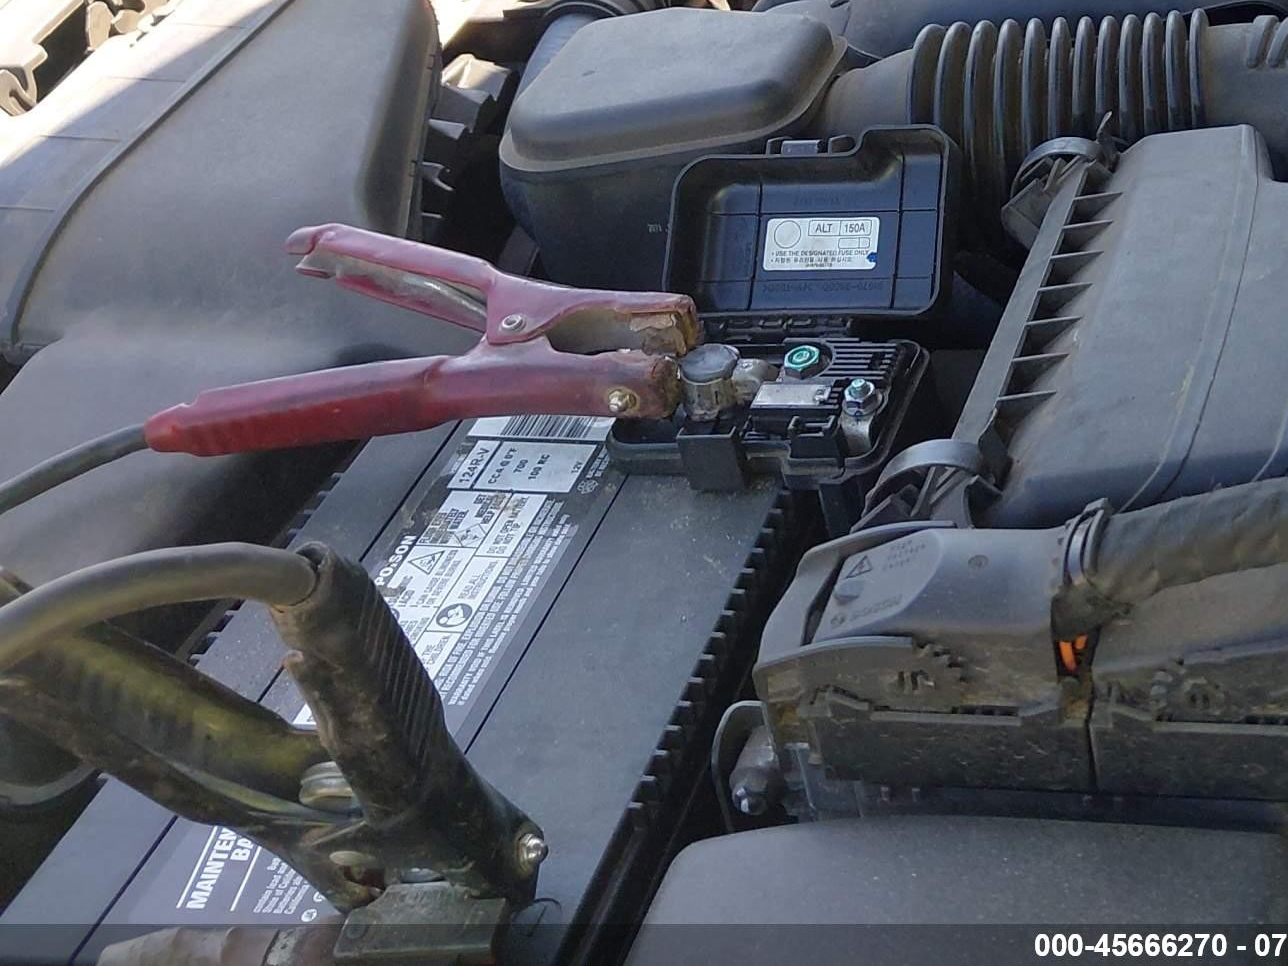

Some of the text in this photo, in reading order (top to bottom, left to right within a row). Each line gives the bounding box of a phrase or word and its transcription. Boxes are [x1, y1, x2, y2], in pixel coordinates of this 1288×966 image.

[815, 223, 833, 233] ALT
[844, 222, 865, 233] 150A
[459, 447, 490, 484] 124R-V
[513, 459, 529, 474] 700
[528, 453, 551, 481] 100 RC
[571, 461, 583, 475] 12V
[488, 466, 504, 484] CCA
